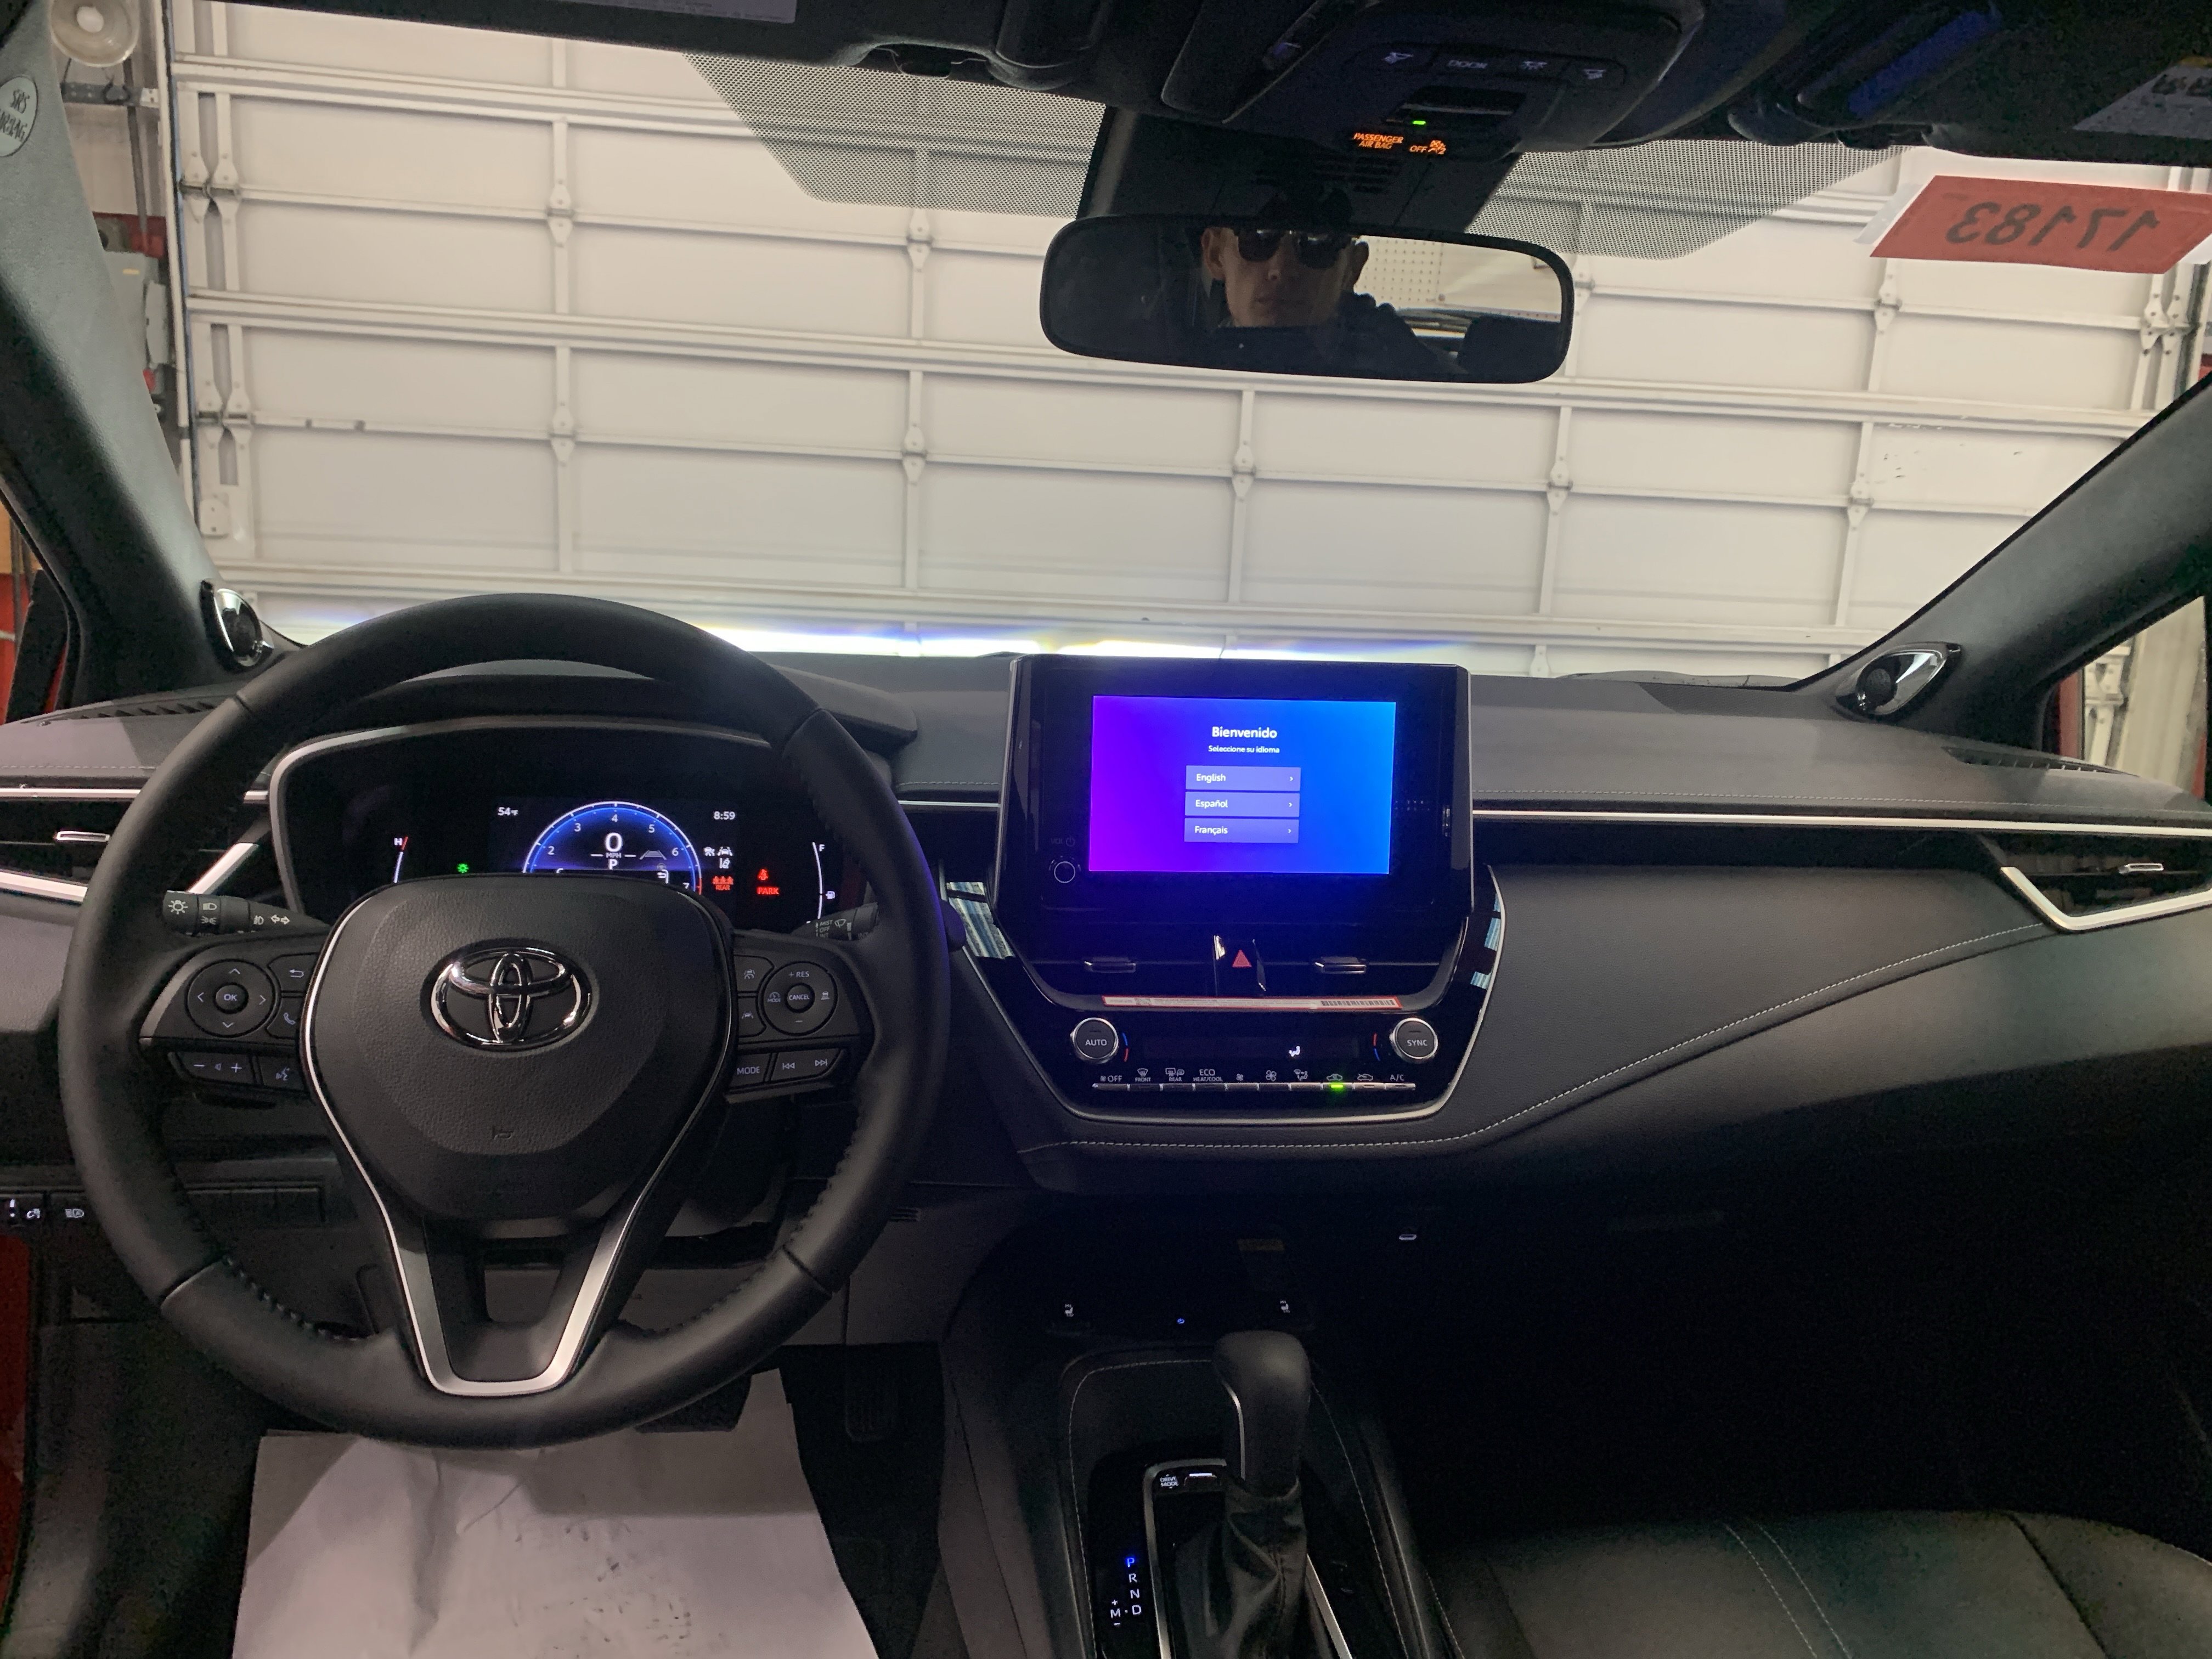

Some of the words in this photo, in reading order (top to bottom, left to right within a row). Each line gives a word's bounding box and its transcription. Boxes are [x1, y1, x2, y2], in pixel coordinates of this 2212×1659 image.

[10, 89, 30, 114] SRS
[1353, 132, 1404, 143] PASSENGER
[1211, 726, 1278, 738] Bienvenido
[1196, 774, 1226, 783] English
[1195, 799, 1228, 809] Español
[611, 814, 618, 823] 4
[714, 811, 736, 820] 8:59
[574, 823, 581, 832] 3
[648, 825, 655, 833] 5
[1194, 826, 1228, 836] Français
[394, 837, 403, 845] H
[548, 847, 555, 855] 2
[672, 848, 679, 856] 6
[608, 859, 618, 870] P
[757, 887, 779, 895] PARK
[737, 1066, 760, 1075] MODE
[1127, 1558, 1135, 1568] P
[1128, 1573, 1138, 1583] R
[1130, 1588, 1140, 1599] N
[1110, 1608, 1121, 1618] M
[1132, 1605, 1142, 1615] D
